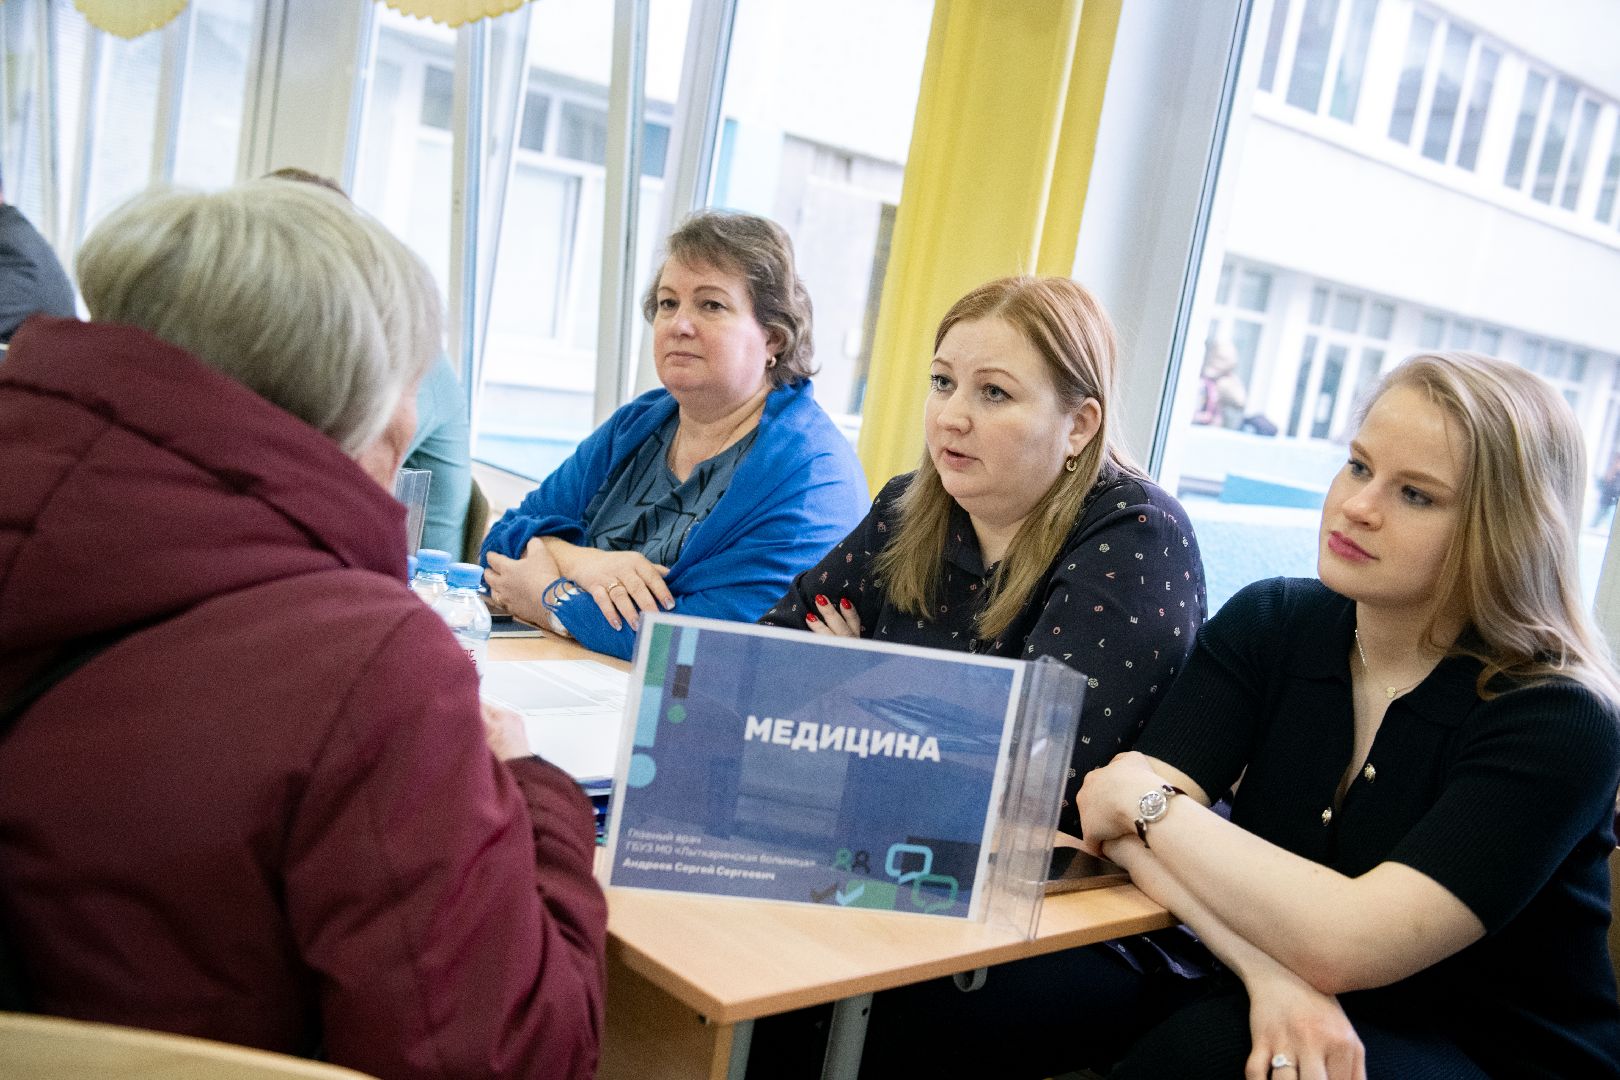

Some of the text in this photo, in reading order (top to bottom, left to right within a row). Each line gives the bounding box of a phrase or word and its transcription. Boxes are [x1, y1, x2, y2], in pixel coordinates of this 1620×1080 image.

[744, 715, 941, 763] МЕДИЦИНА
[655, 844, 673, 855] МО
[622, 857, 776, 881] Андреев Сергей Сергеевич
